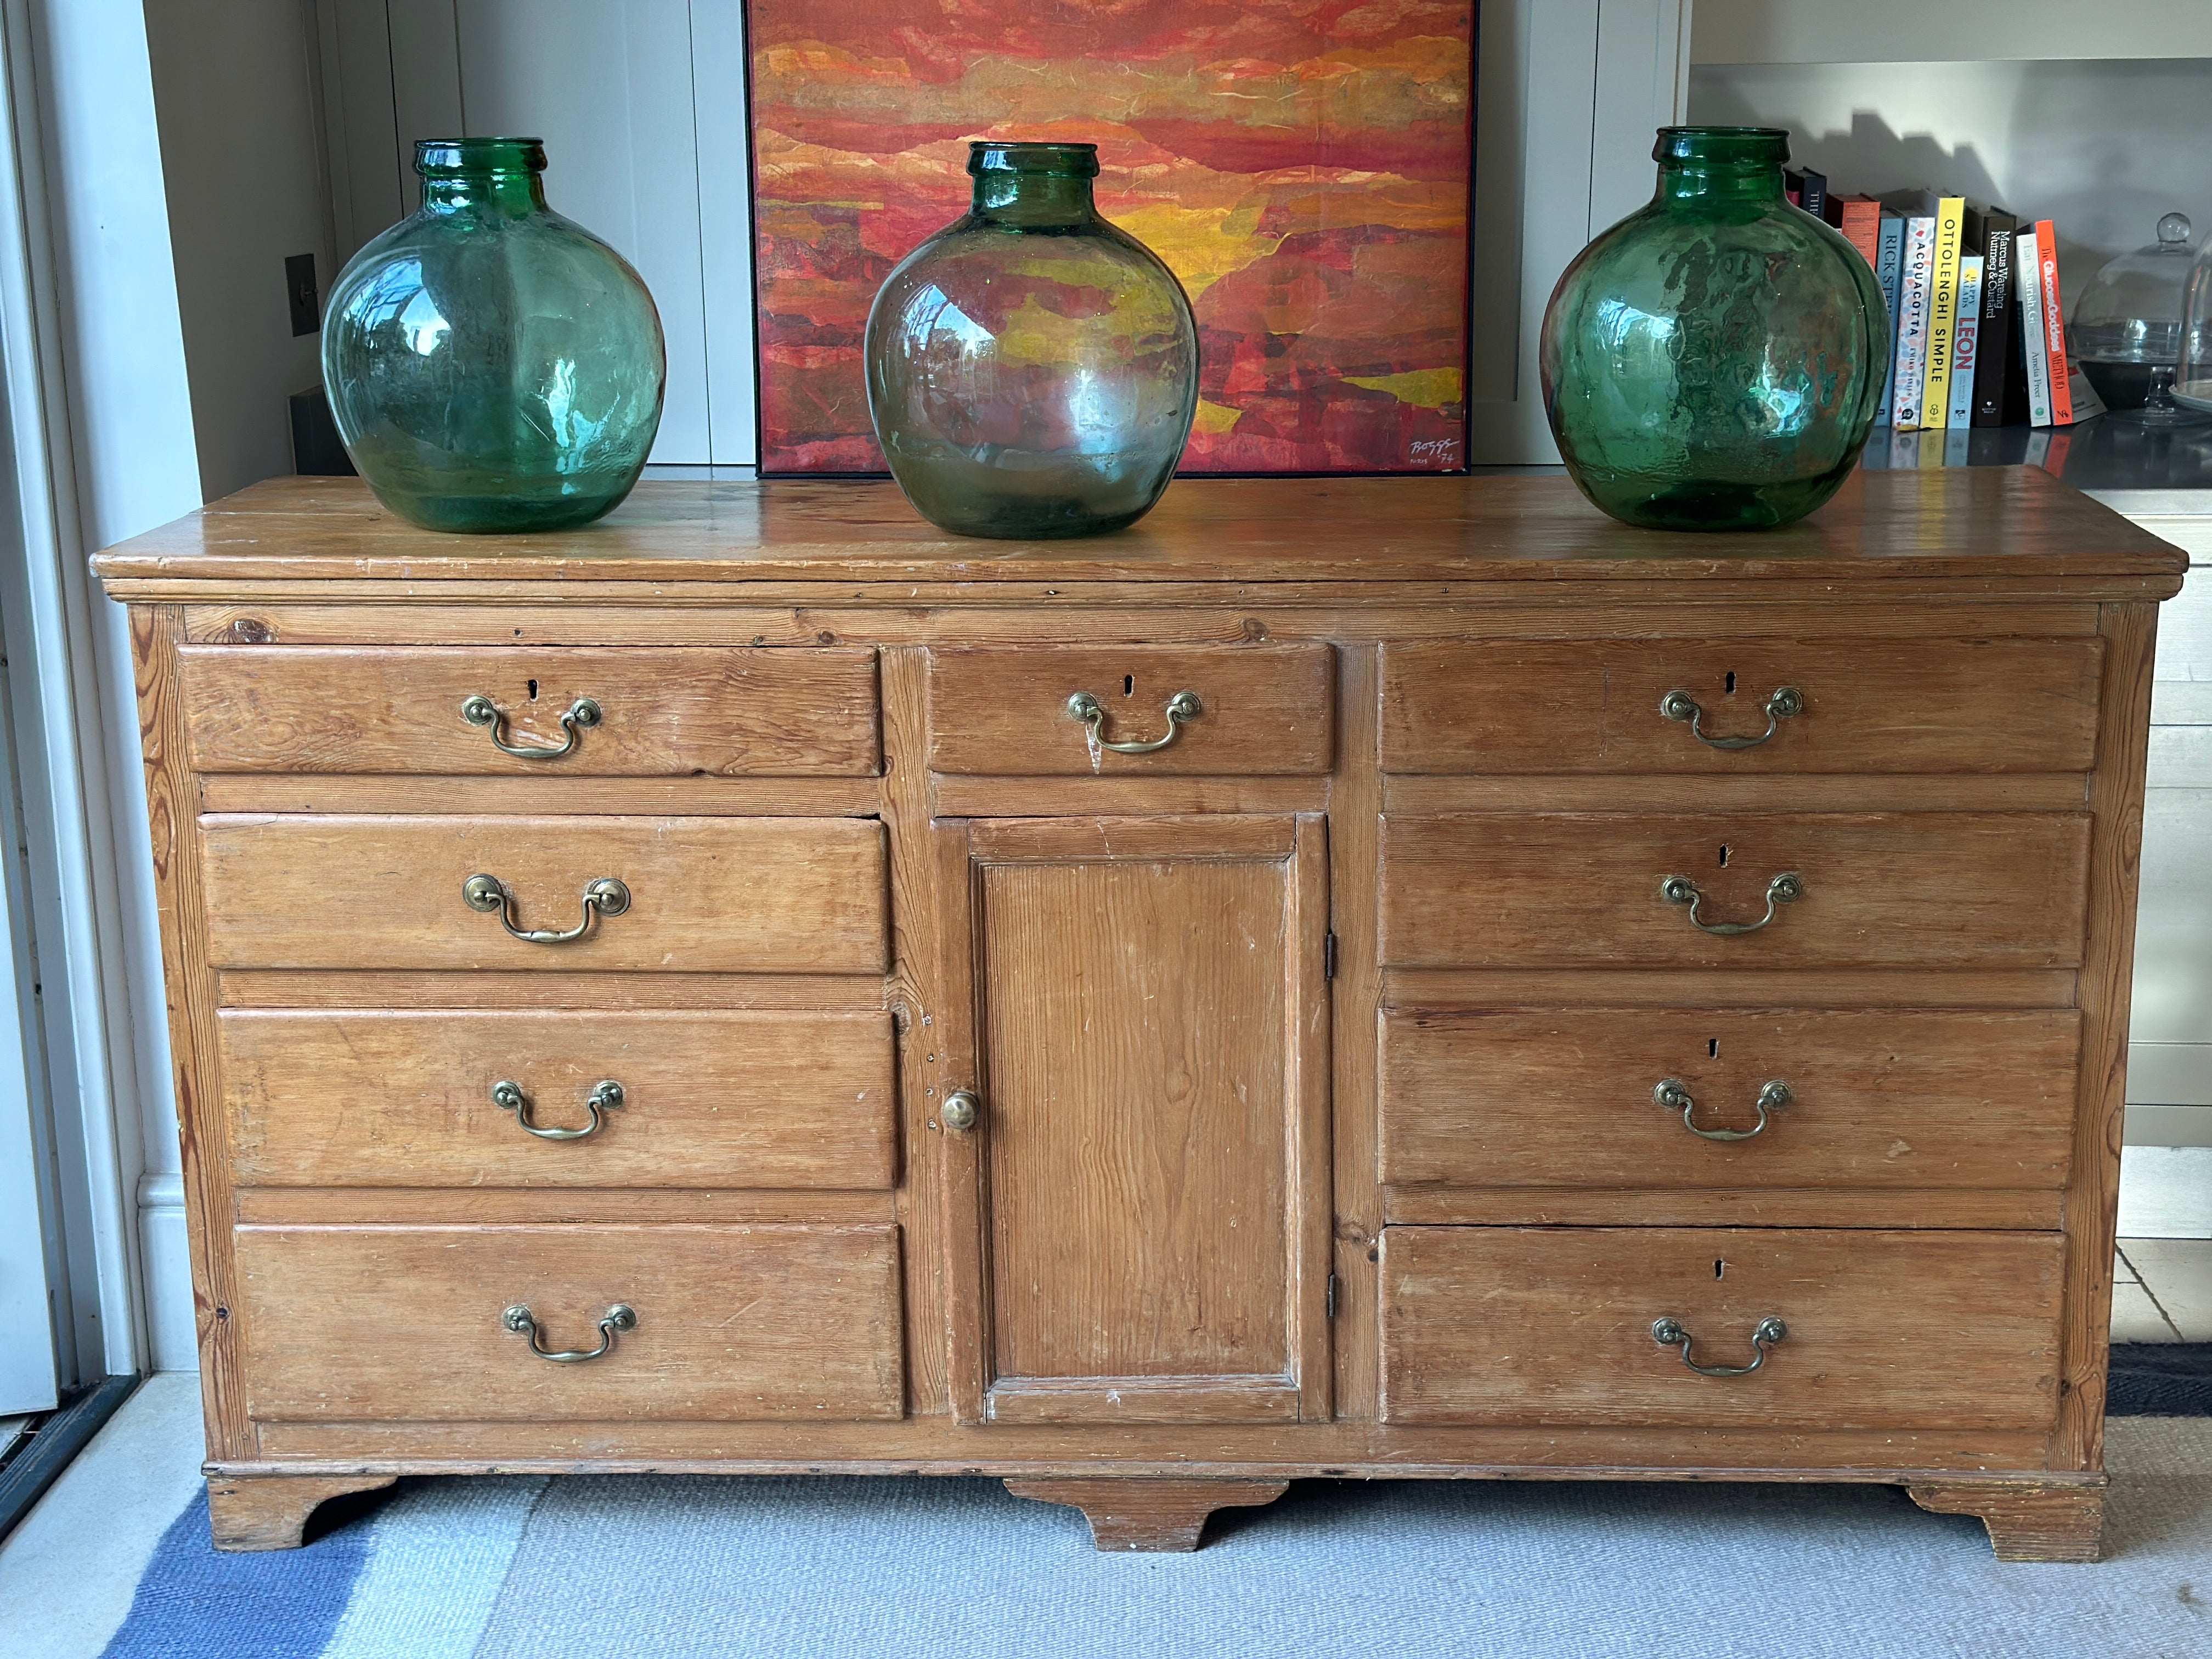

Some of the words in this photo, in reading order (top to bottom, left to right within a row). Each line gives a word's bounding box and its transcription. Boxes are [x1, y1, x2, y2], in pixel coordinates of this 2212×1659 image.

[1883, 235, 1898, 272] RICK
[1987, 231, 2000, 270] Nutmeg
[1999, 230, 2010, 267] Marcus
[1937, 219, 1955, 319] OTTOLENGHI
[1989, 272, 1998, 280] &
[1994, 267, 2008, 309] Wareing
[1883, 275, 1894, 314] STE
[1910, 242, 1925, 336] ACQUACOTTA
[1962, 273, 1971, 308] SALADS
[1968, 276, 1977, 306] HAPPY
[1986, 281, 1998, 319] Custard
[1931, 329, 1946, 382] SIMPLE
[1955, 318, 1976, 370] LEON
[2032, 352, 2040, 377] Amelia
[2052, 354, 2065, 389] METHOD
